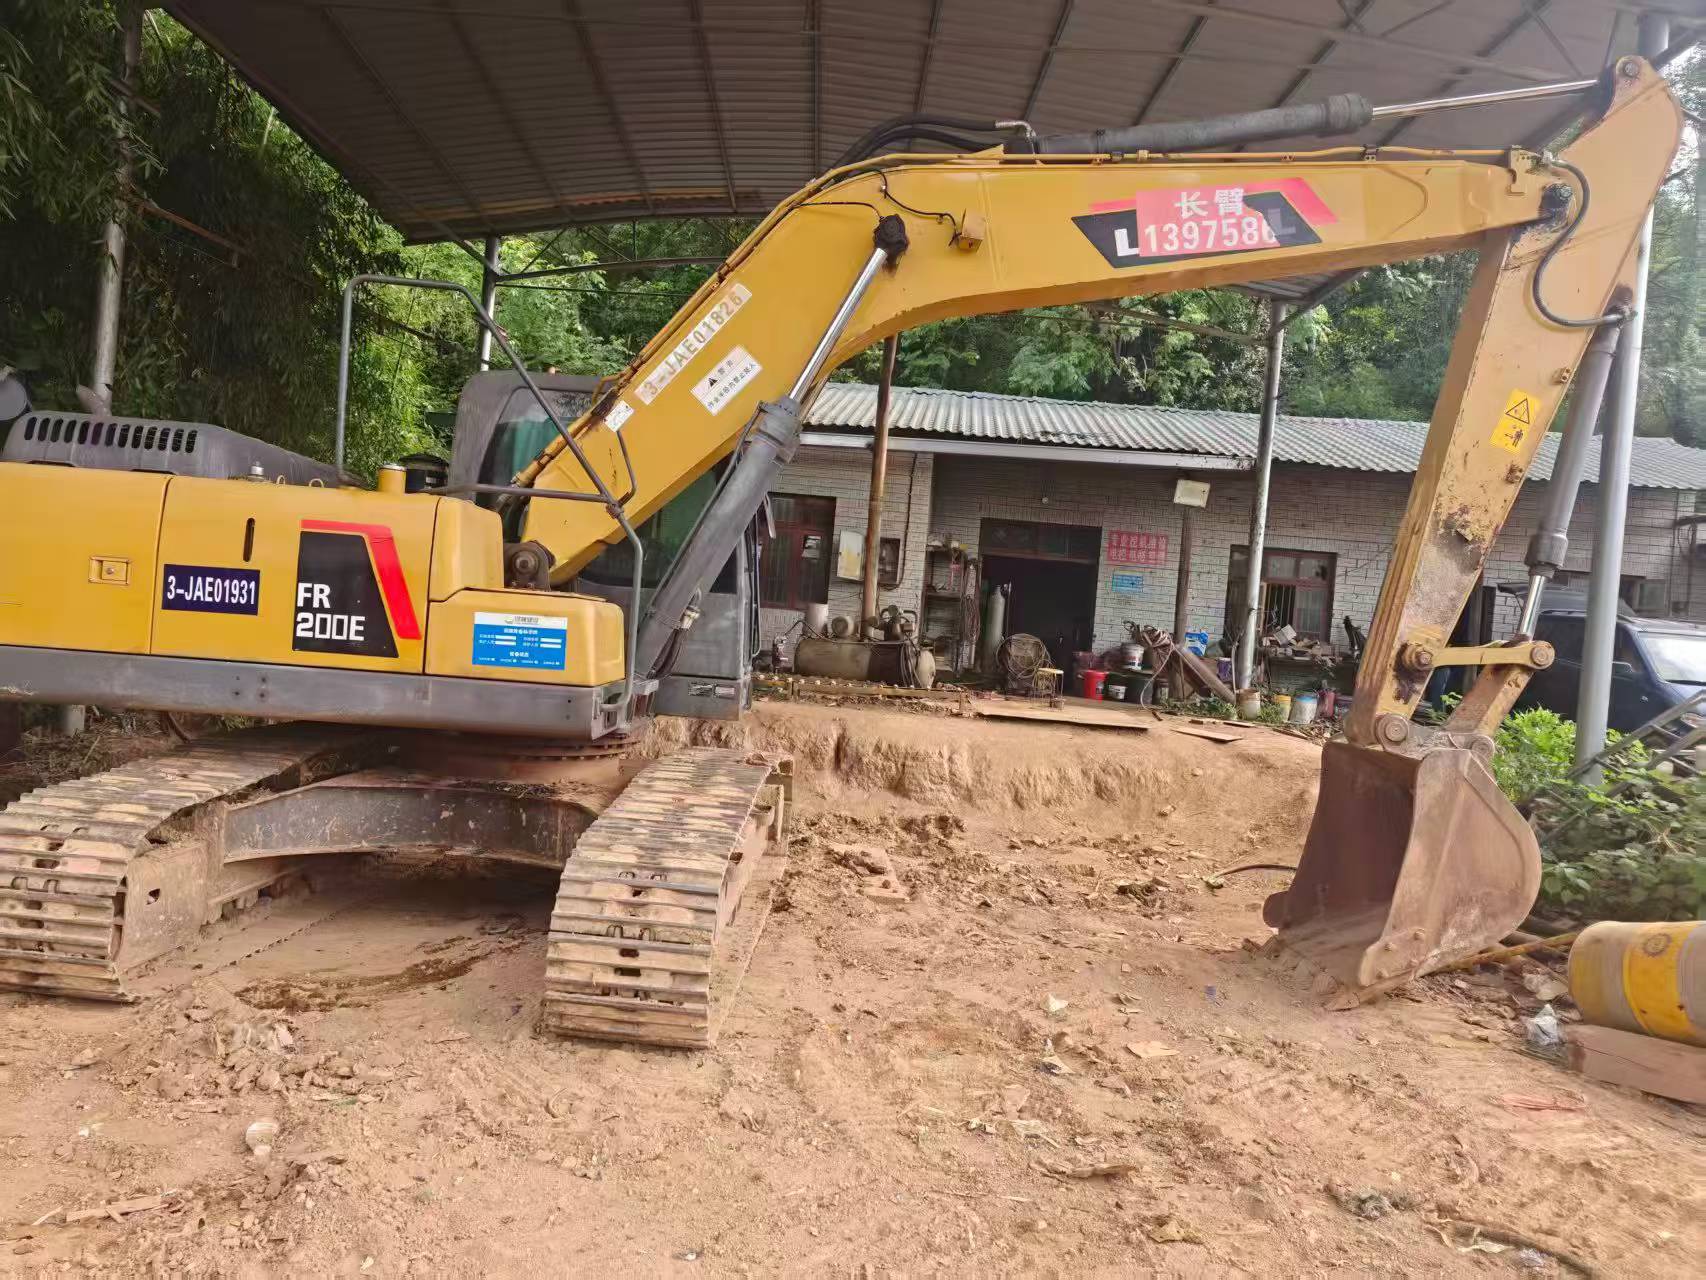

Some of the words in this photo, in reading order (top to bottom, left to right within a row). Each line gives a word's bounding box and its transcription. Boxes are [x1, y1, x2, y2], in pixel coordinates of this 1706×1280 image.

[1174, 187, 1244, 219] 长臂
[167, 575, 256, 605] 3-JAE01931
[297, 582, 331, 608] FR
[296, 612, 365, 641] 200E
